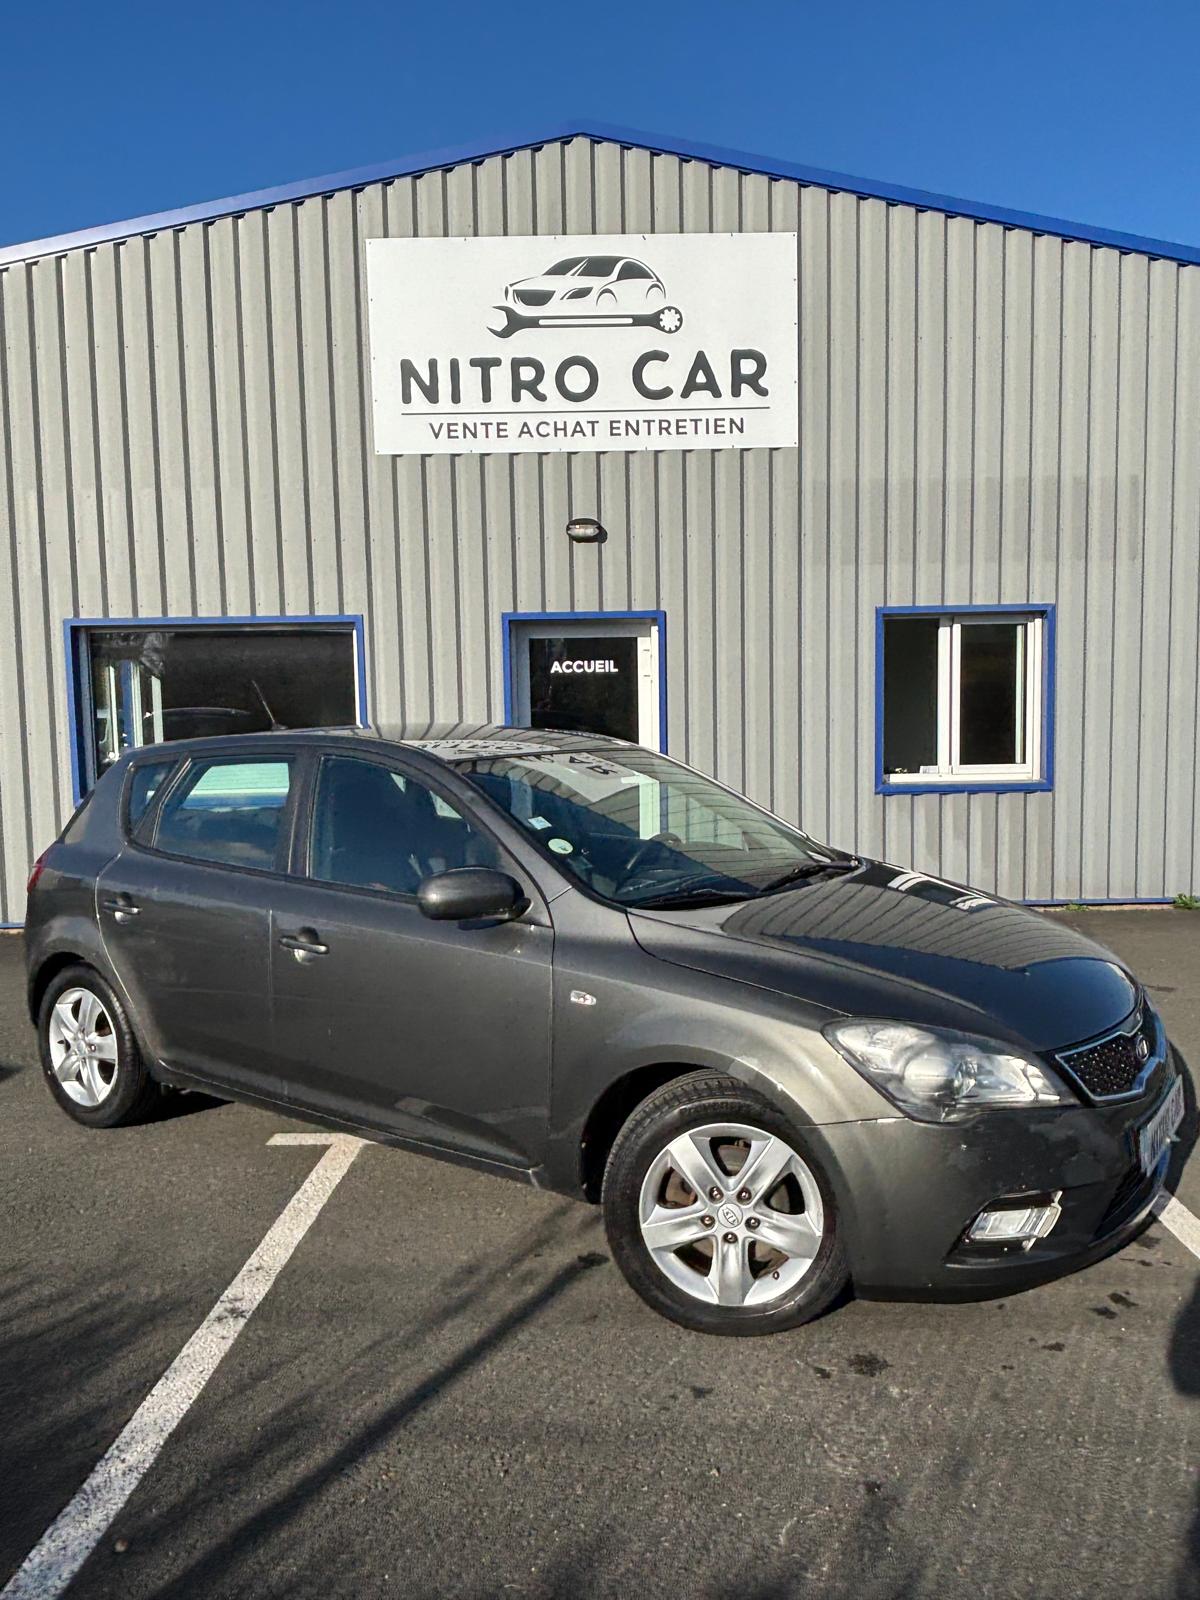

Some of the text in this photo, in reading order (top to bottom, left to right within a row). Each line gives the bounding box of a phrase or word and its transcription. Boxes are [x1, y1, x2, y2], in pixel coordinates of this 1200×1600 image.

[400, 348, 769, 405] NITRO CAR
[429, 417, 744, 440] VENTE ACHAT ENTRETIEN
[550, 659, 619, 674] ACCUEIL
